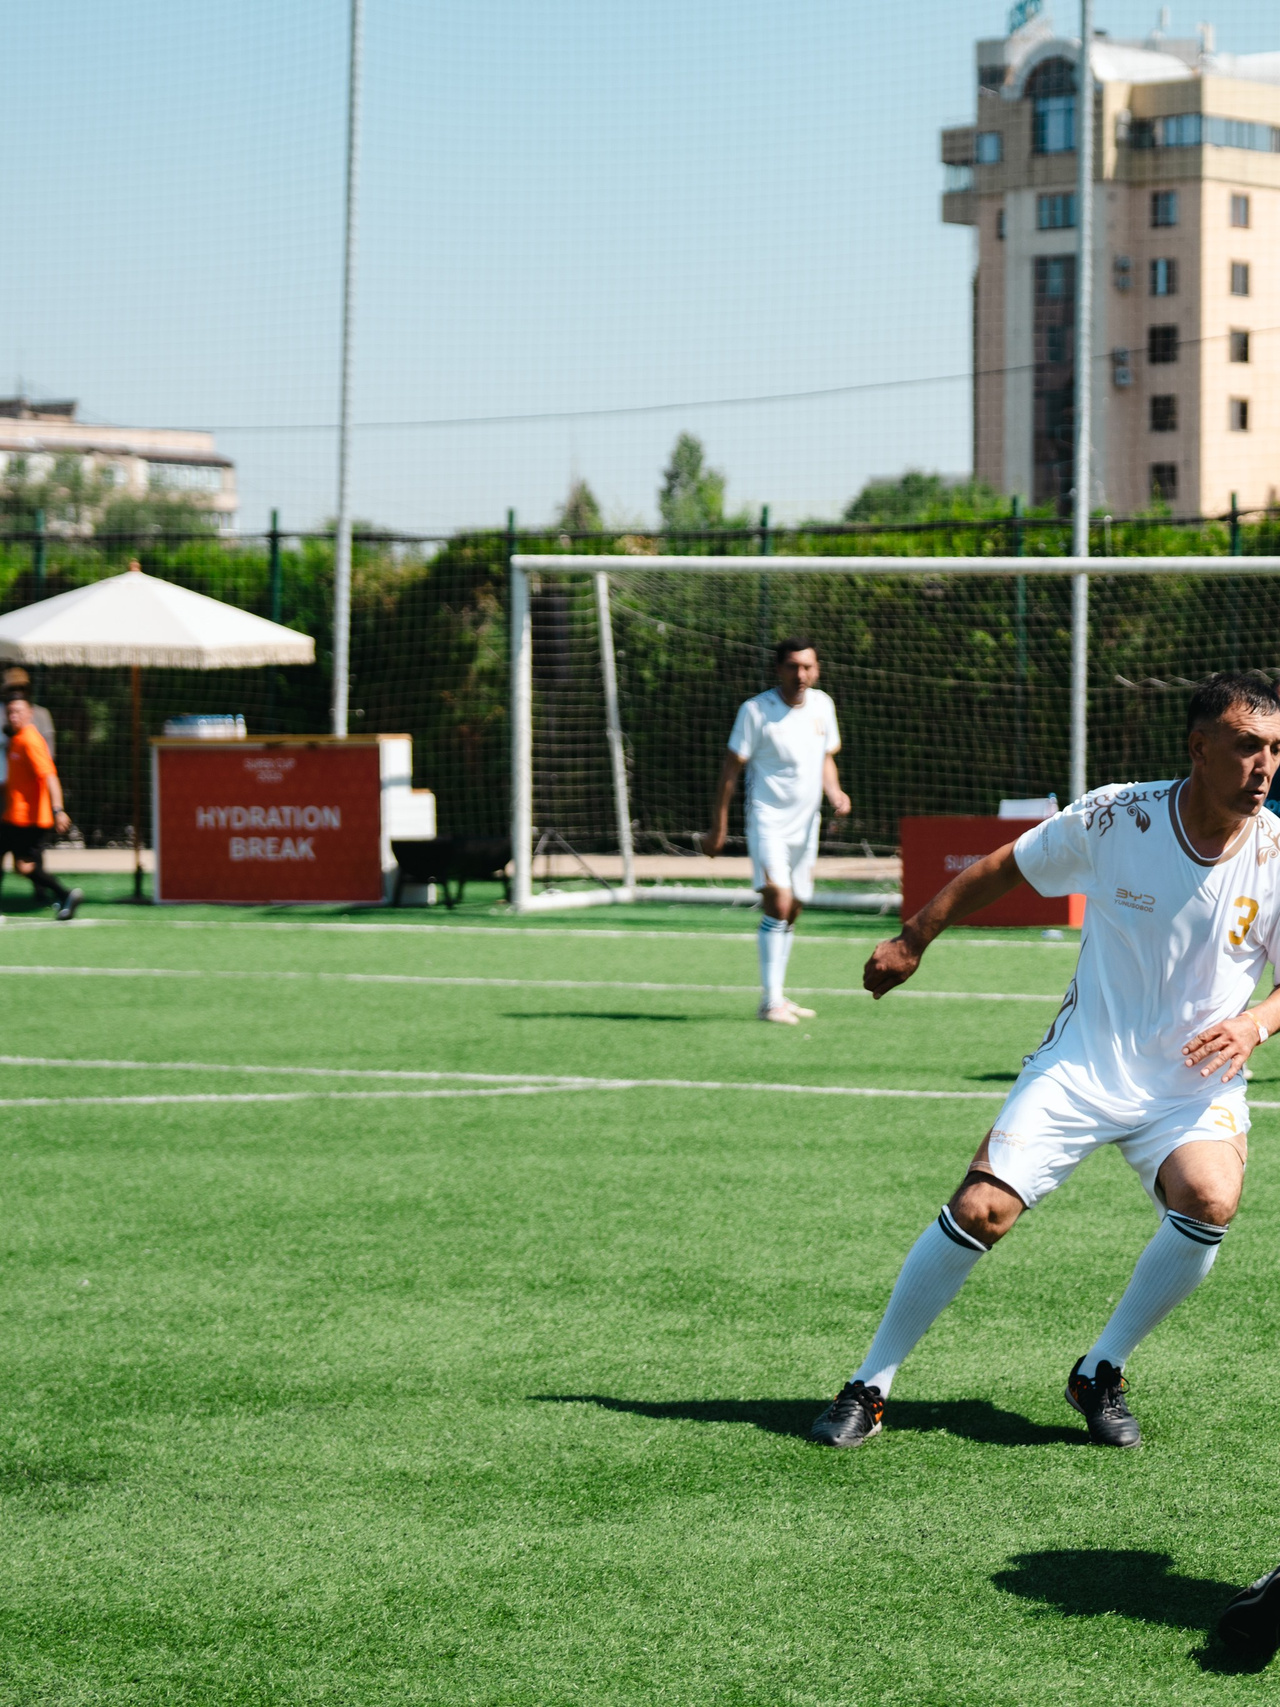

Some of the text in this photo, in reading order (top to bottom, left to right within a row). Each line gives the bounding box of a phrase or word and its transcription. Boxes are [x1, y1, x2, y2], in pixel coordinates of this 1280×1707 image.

[196, 805, 341, 830] HYDRATION
[229, 836, 316, 860] BREAK
[1115, 887, 1156, 906] BYD
[1228, 895, 1259, 946] 3
[1209, 1105, 1237, 1134] 3
